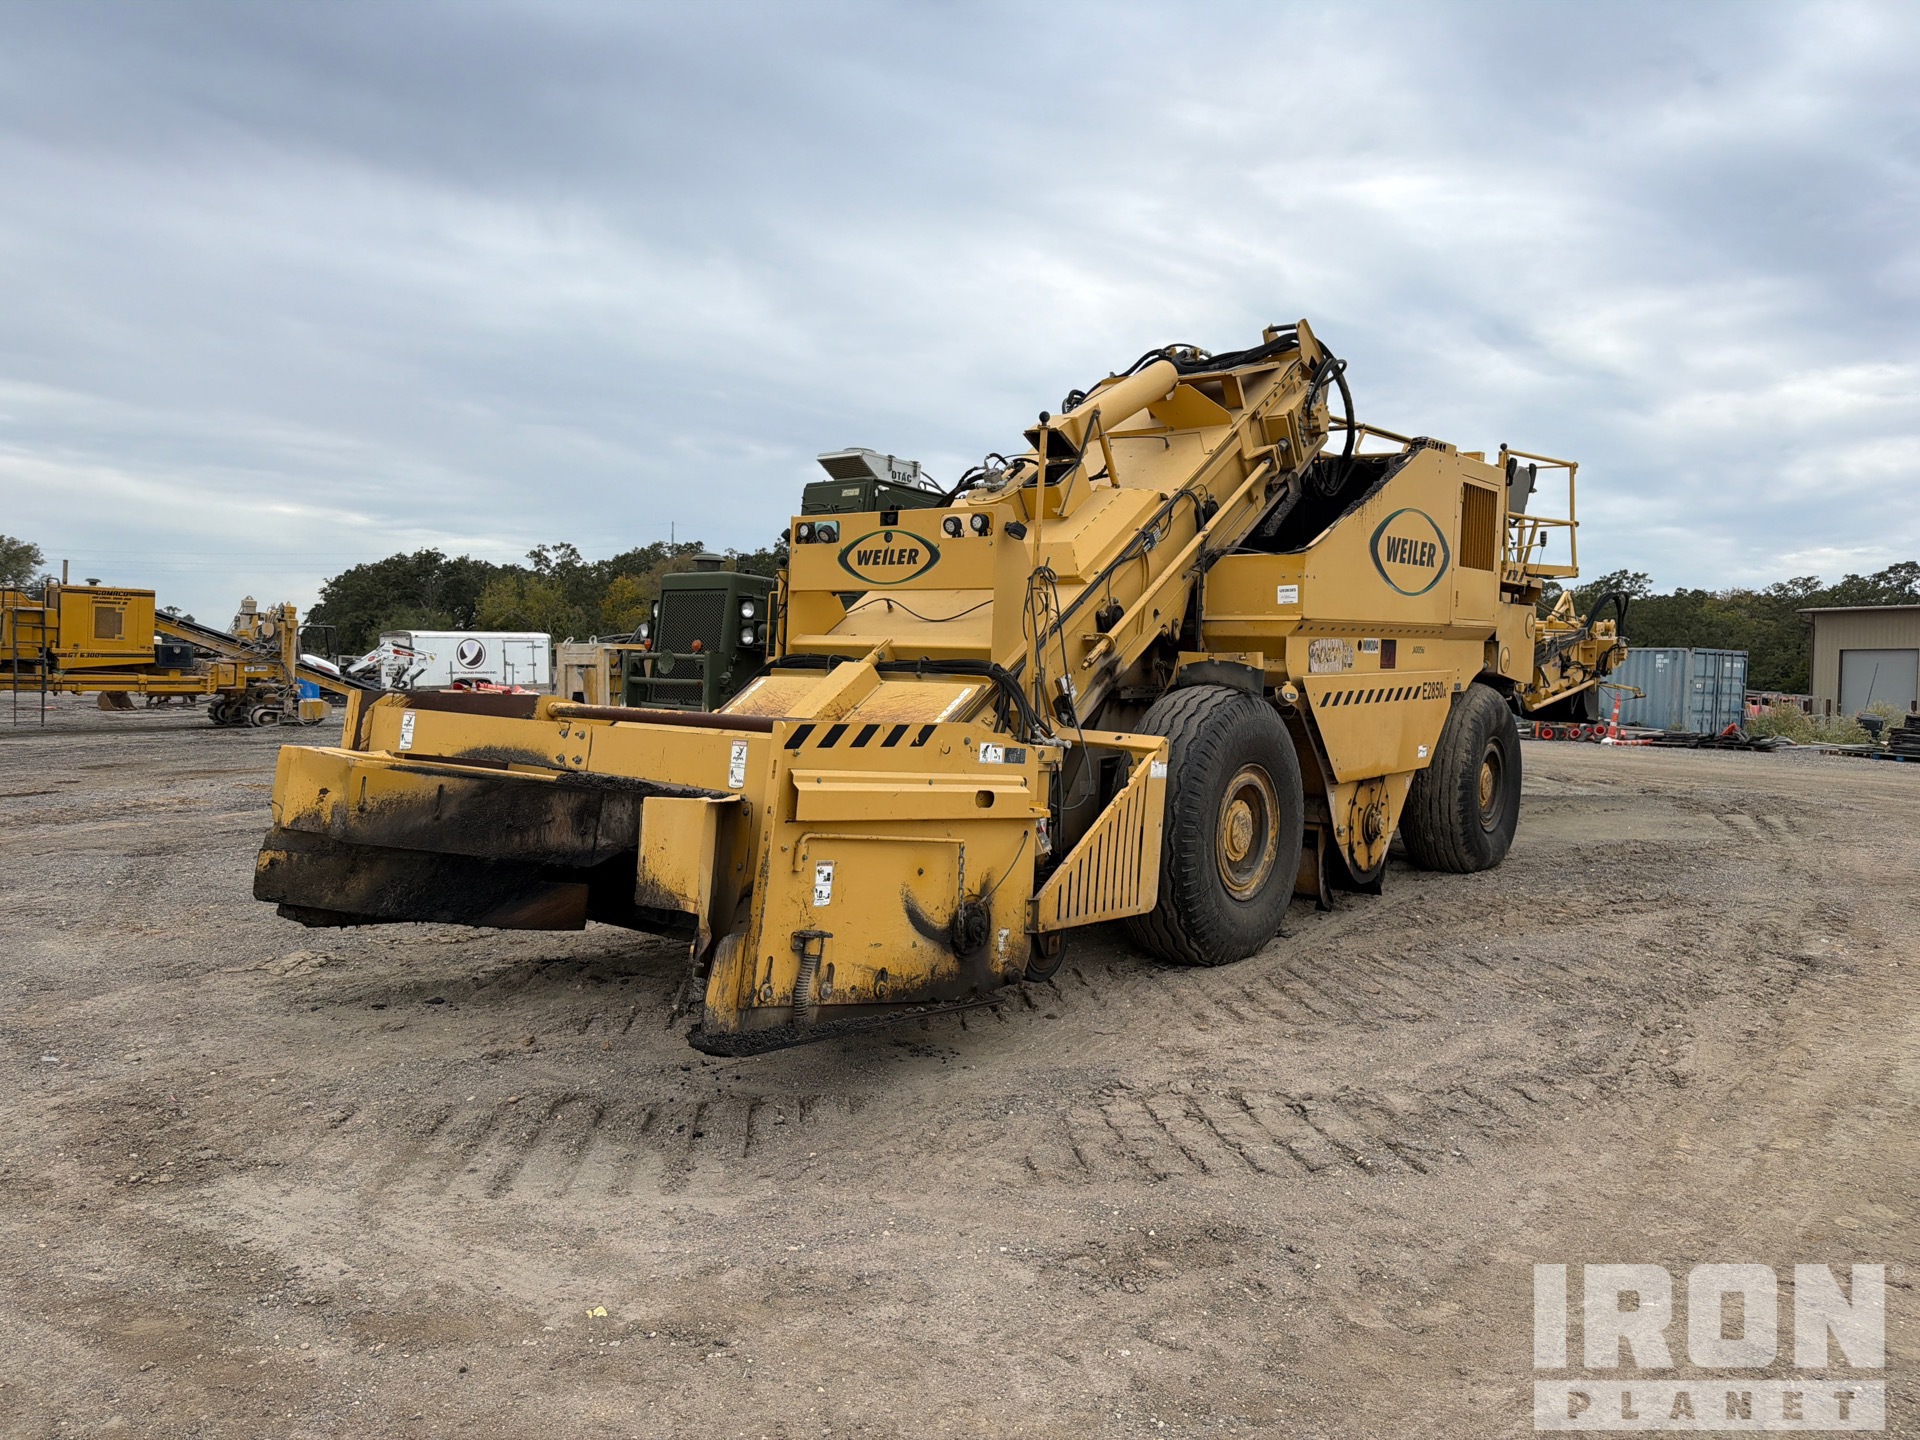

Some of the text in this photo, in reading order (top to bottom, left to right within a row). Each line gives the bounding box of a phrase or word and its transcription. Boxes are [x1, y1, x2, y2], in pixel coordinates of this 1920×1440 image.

[891, 470, 912, 483] DTAC
[857, 548, 919, 566] WEILER
[1387, 536, 1437, 568] WEILER
